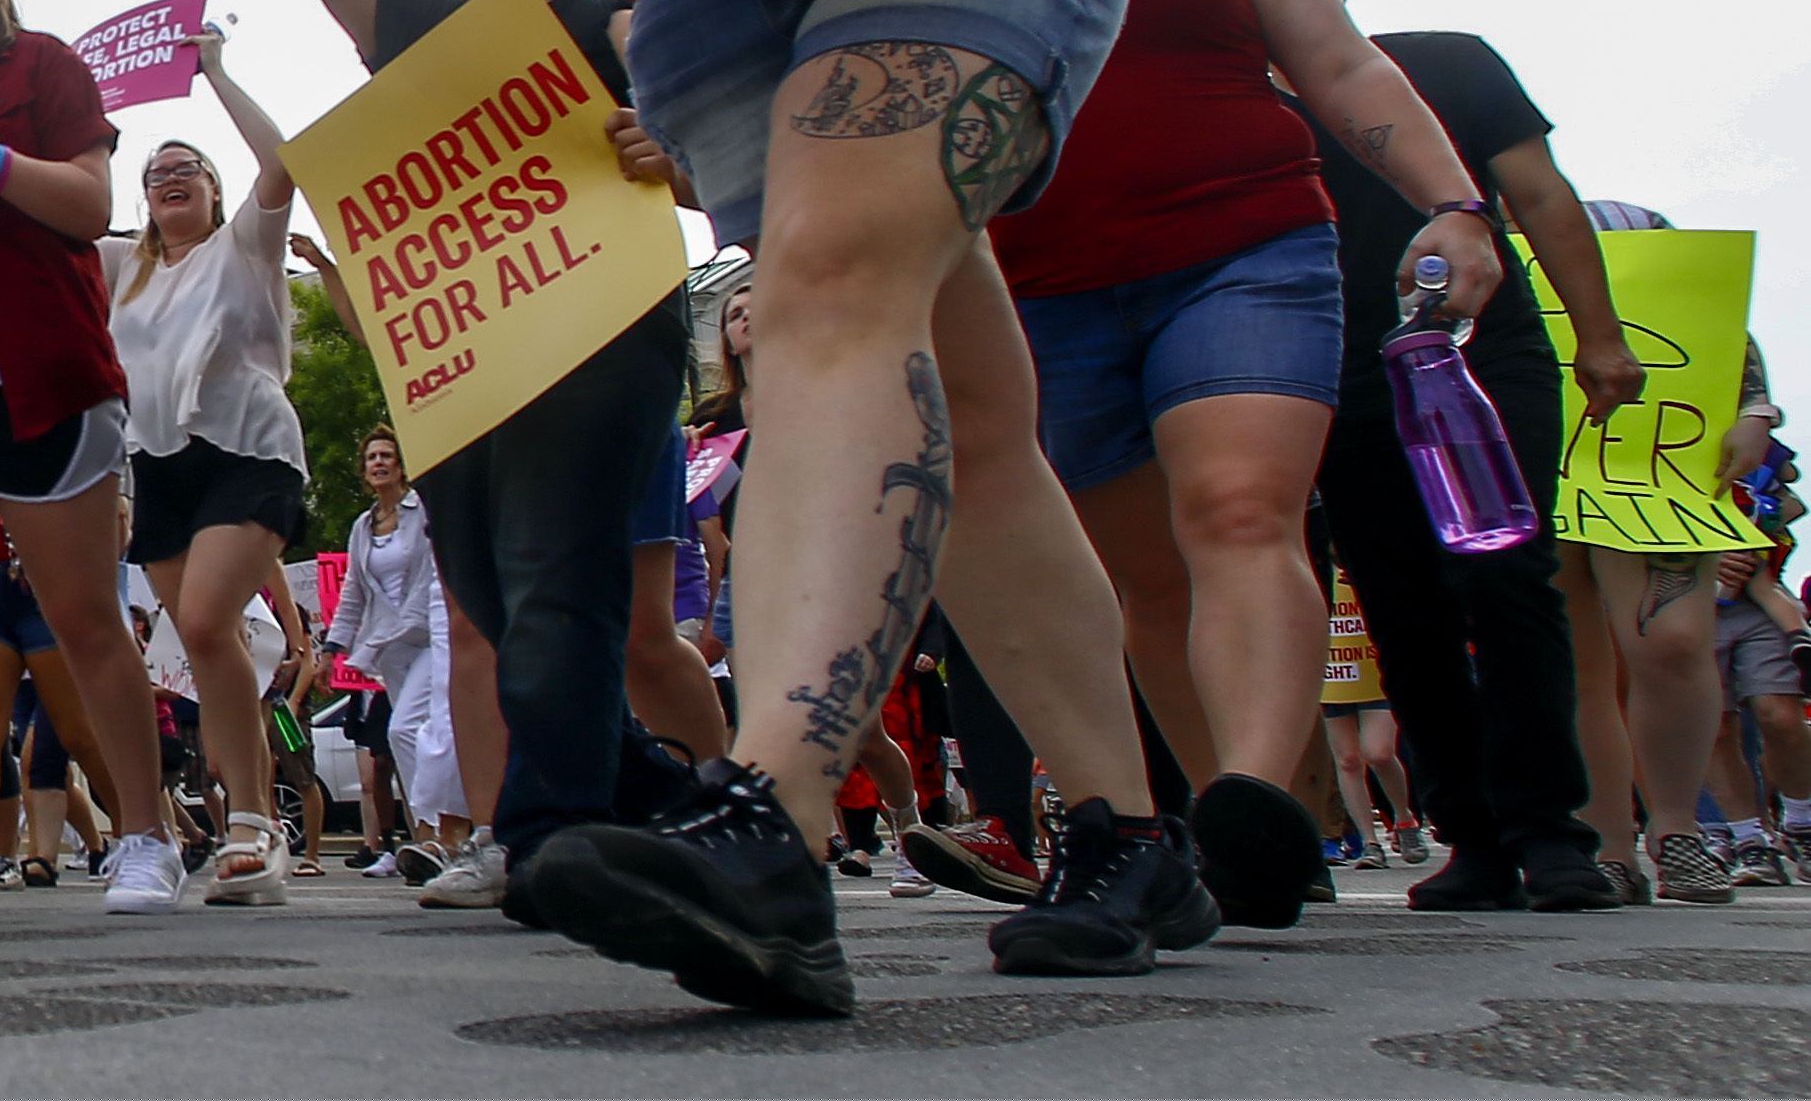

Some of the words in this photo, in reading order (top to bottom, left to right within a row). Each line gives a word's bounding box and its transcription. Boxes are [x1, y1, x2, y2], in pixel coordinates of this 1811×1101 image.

[76, 6, 173, 56] PROTECT
[115, 23, 186, 57] LEGAL
[337, 48, 591, 255] ABORTION
[365, 155, 569, 313] ACCESS
[385, 279, 488, 368] FOR
[494, 224, 603, 309] ALL.
[407, 348, 475, 406] ACLU
